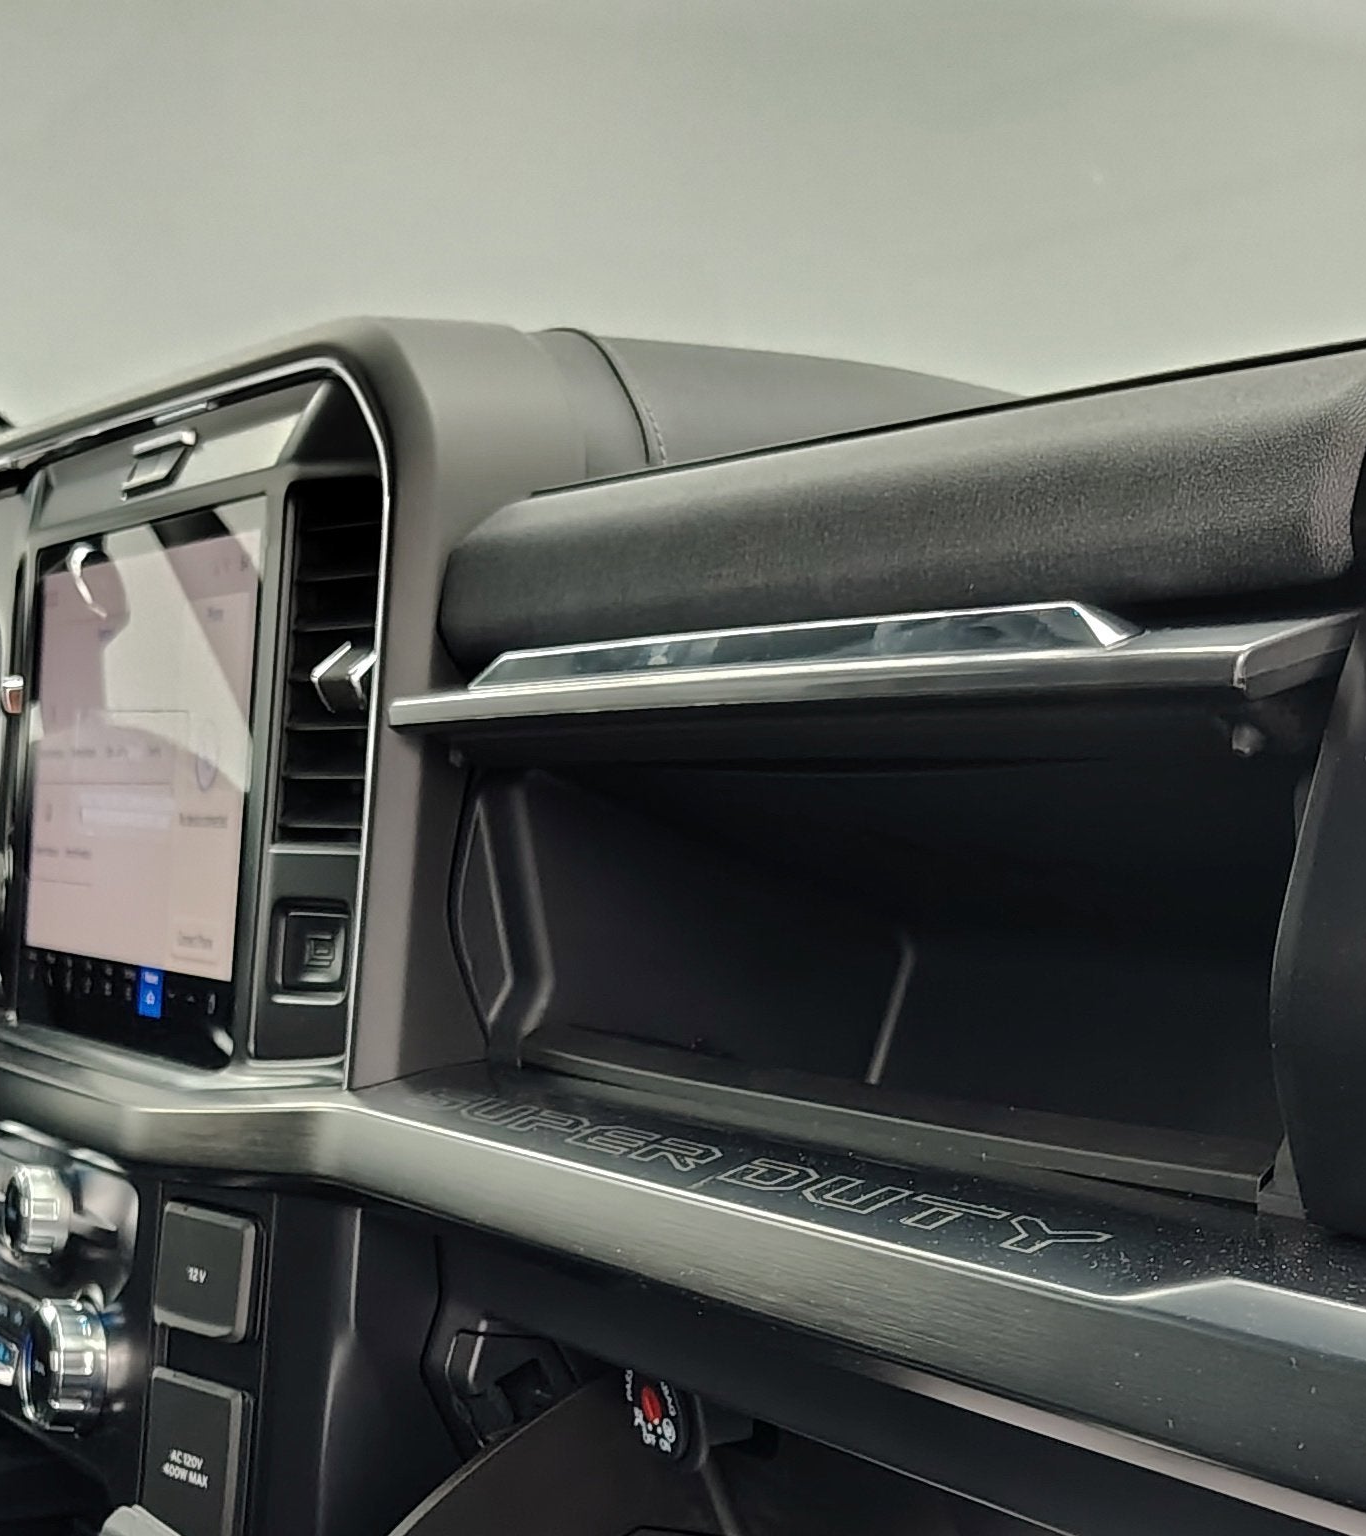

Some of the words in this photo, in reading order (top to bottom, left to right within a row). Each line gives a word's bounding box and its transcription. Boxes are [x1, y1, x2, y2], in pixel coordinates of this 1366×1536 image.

[404, 1088, 723, 1172] SUPER
[716, 1158, 1114, 1254] DUTY
[187, 1266, 207, 1284] 12V
[170, 1449, 183, 1463] AC
[182, 1452, 203, 1470] 120V
[162, 1462, 187, 1482] 400W
[188, 1472, 209, 1489] MAX
